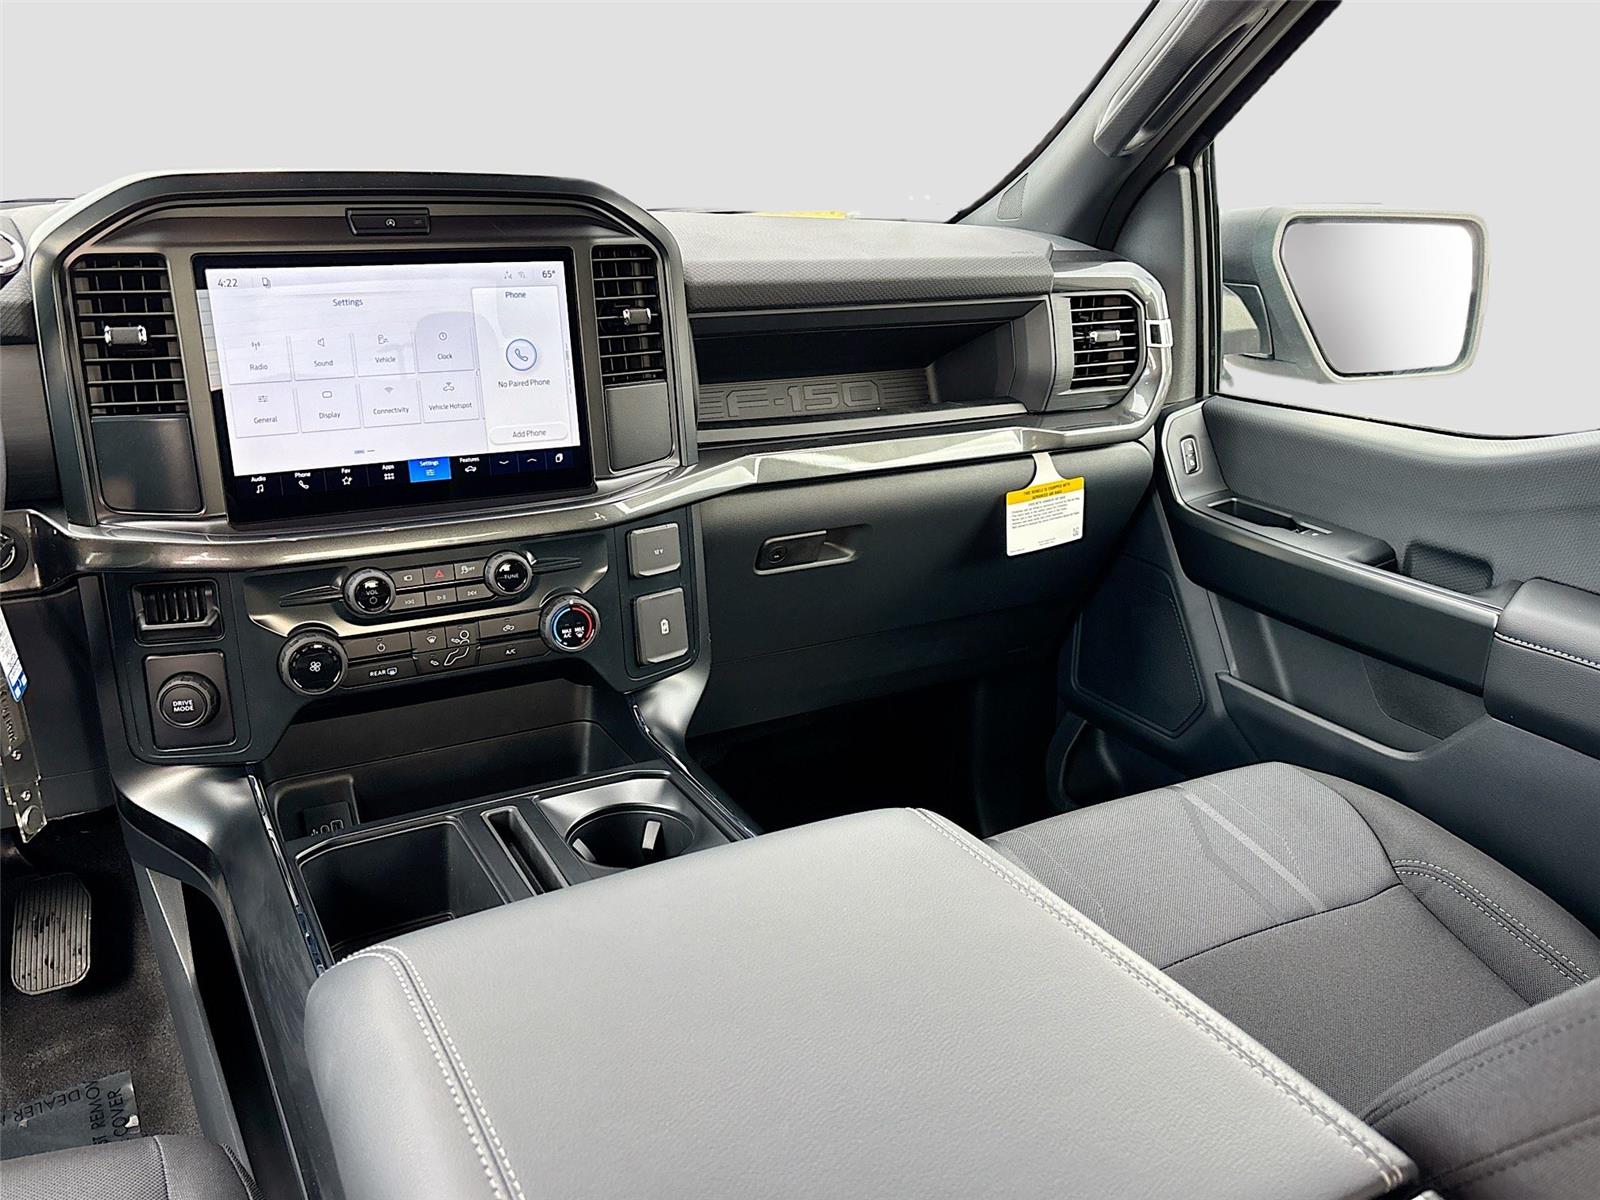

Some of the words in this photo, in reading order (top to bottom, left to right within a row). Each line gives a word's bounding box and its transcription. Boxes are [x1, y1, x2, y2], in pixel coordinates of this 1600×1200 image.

[217, 278, 239, 288] 4:22
[505, 291, 527, 299] Phone
[332, 298, 364, 307] Settings
[250, 363, 269, 371] Radio
[508, 379, 530, 388] Paired
[530, 378, 551, 386] Phone
[726, 379, 881, 418] F-150
[373, 407, 410, 415] Connectivity
[428, 403, 449, 411] Vehicle
[449, 402, 473, 410] Hotspot
[253, 416, 278, 424] General
[318, 412, 341, 420] Display
[512, 430, 526, 438] Add
[526, 429, 547, 437] Phone
[369, 669, 386, 677] REAR
[14, 1089, 81, 1122] DEALER
[107, 1087, 129, 1137] COVER
